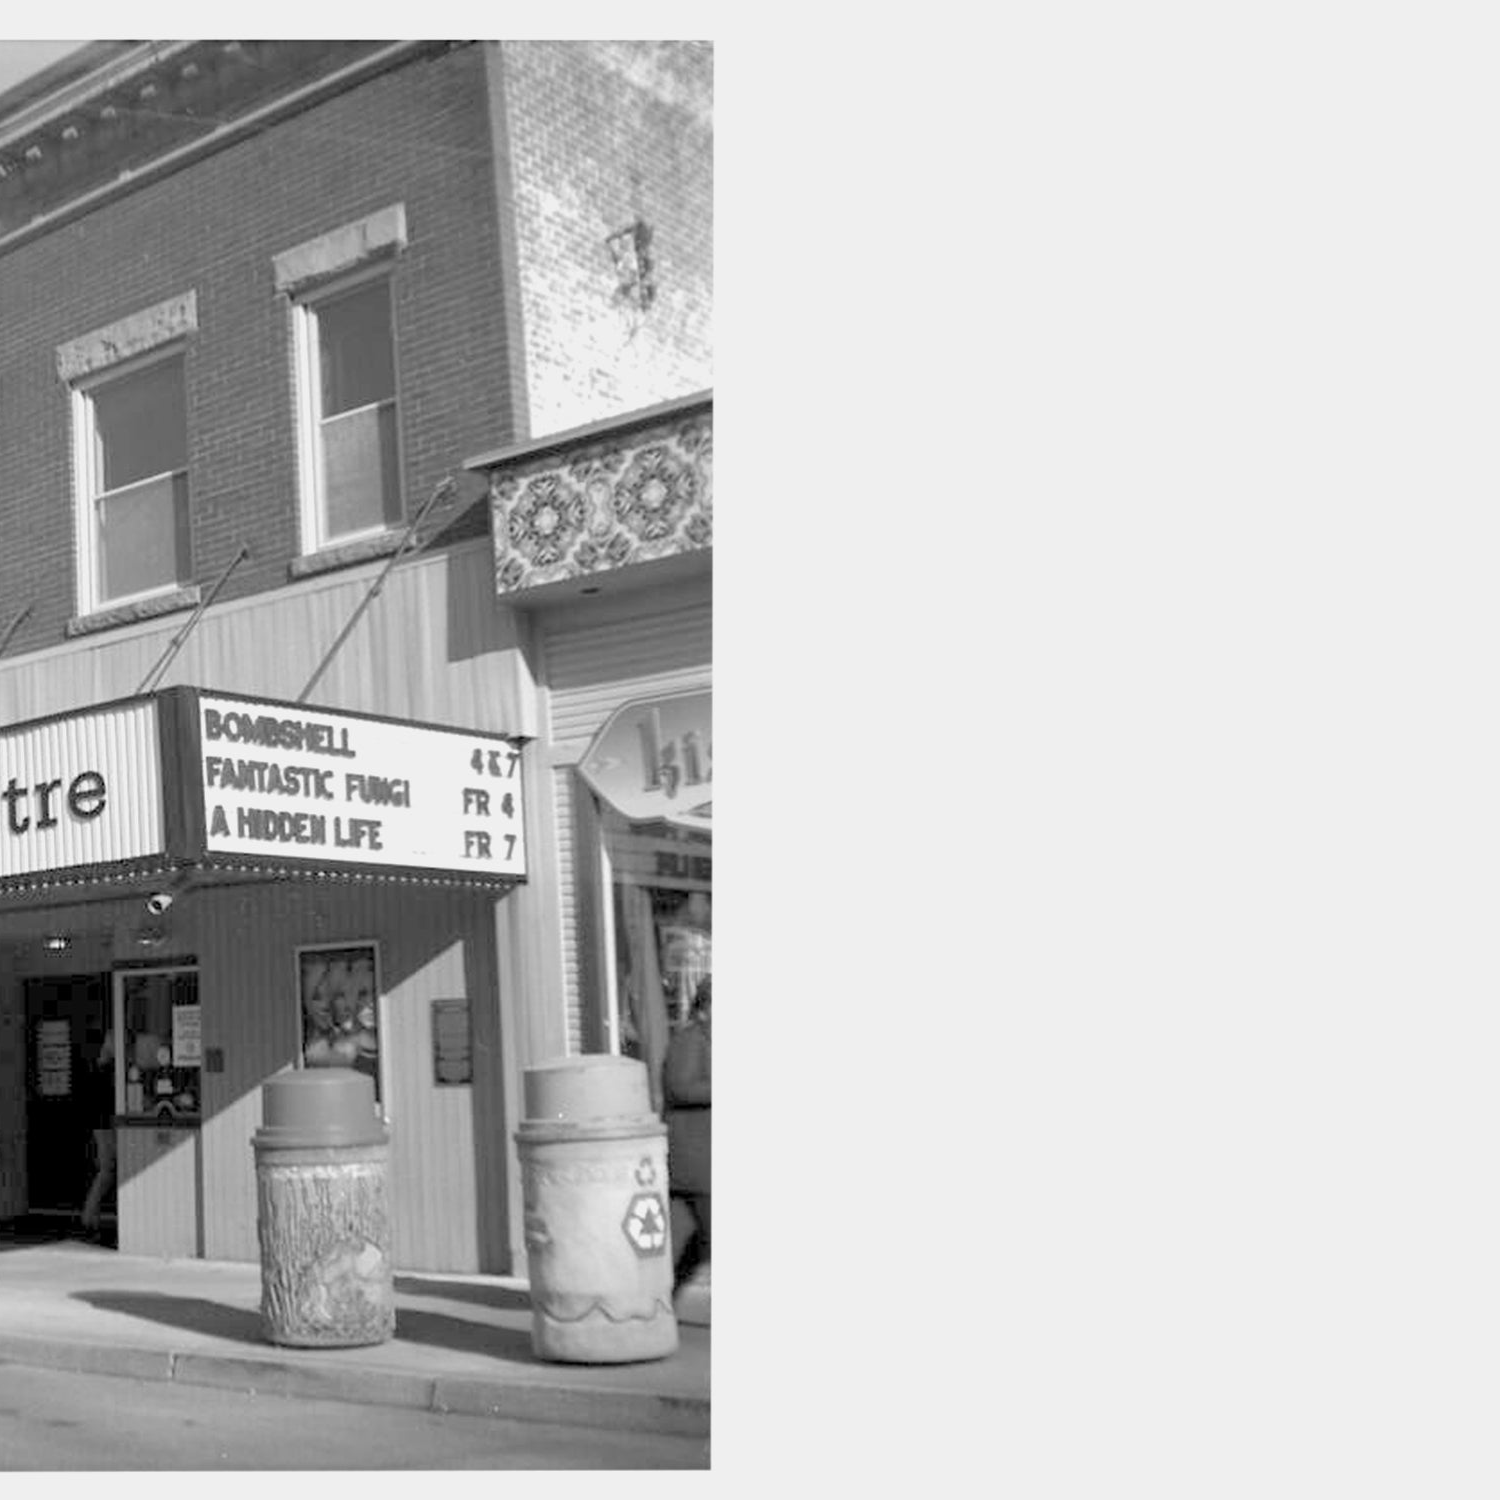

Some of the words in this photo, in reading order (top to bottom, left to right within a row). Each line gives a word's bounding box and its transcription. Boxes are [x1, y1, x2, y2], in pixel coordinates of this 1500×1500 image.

[204, 708, 356, 759] BOMBSHELL
[206, 756, 334, 800] FANTASTIC
[345, 773, 411, 808] FUNGI
[462, 787, 491, 817] FR
[501, 792, 515, 819] 4
[210, 805, 231, 837] A
[237, 807, 326, 845] HIDDEN
[334, 816, 383, 851] LIFE
[463, 830, 492, 859] FR
[503, 834, 517, 860] 7
